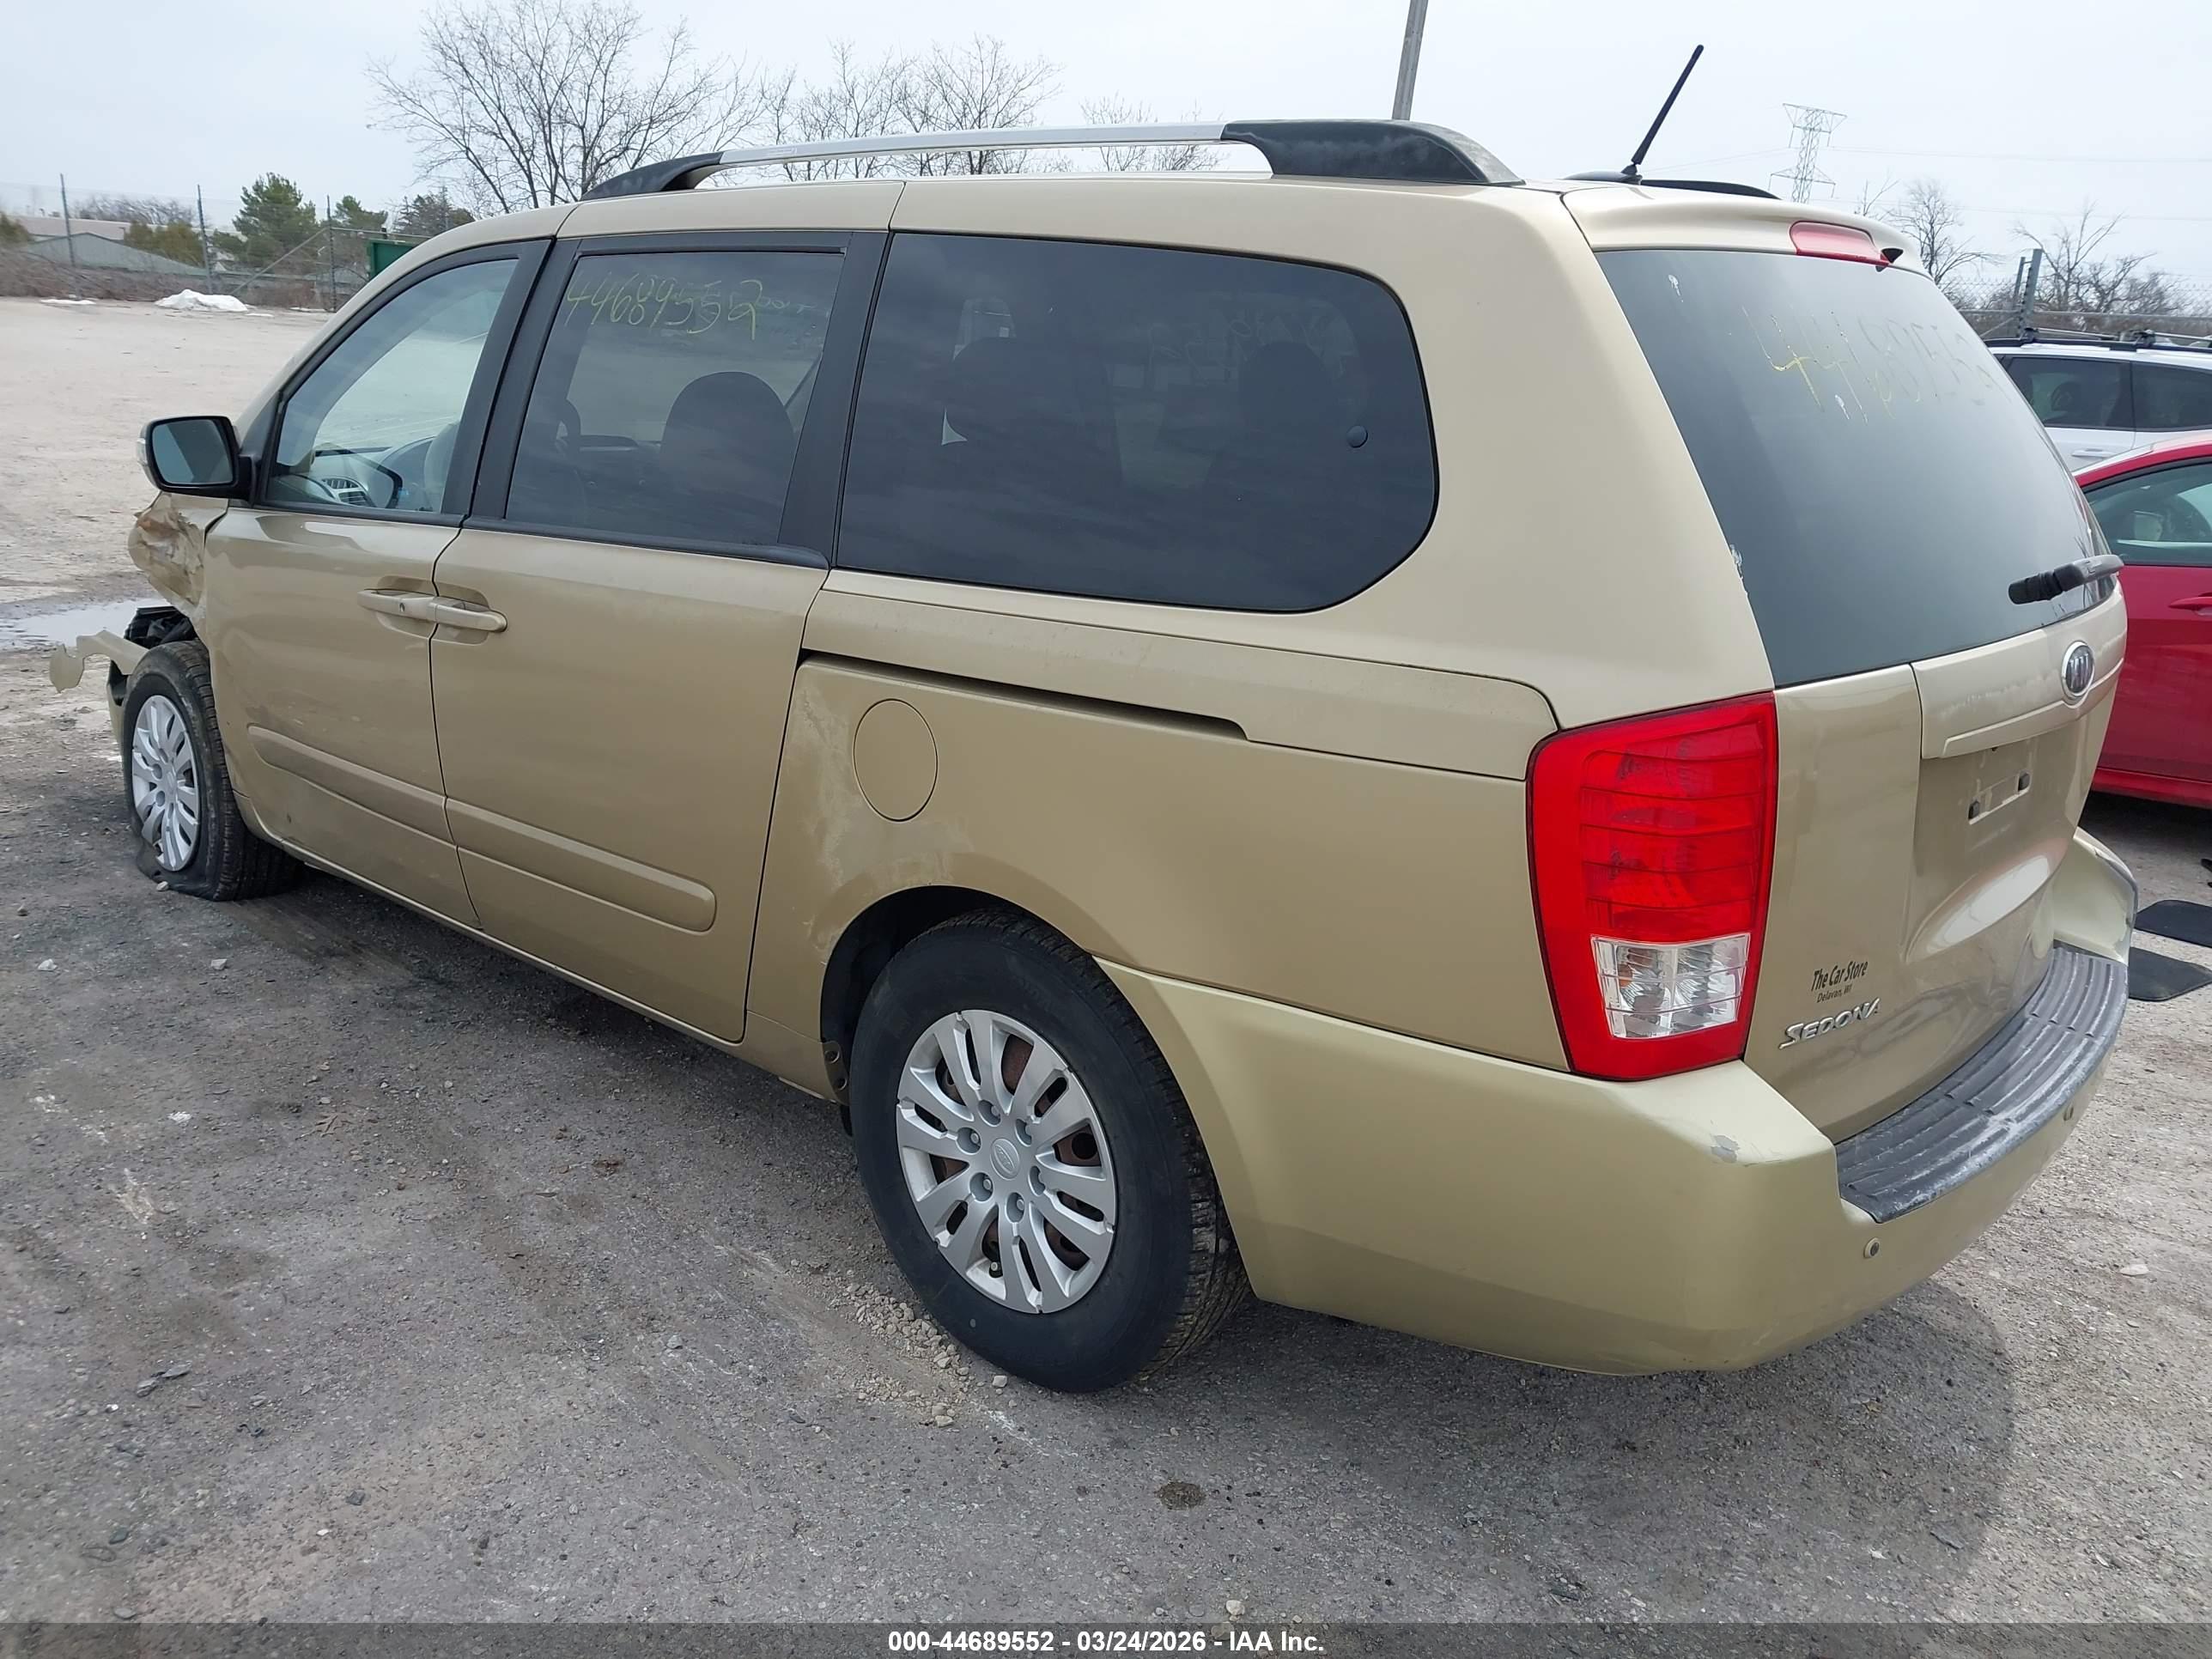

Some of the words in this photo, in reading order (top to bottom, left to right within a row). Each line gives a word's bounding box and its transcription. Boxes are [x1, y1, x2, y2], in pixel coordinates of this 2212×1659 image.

[1811, 968, 1827, 991] The
[1829, 964, 1845, 986] Car
[1844, 960, 1869, 981] Store
[1778, 997, 1881, 1049] SEDONA
